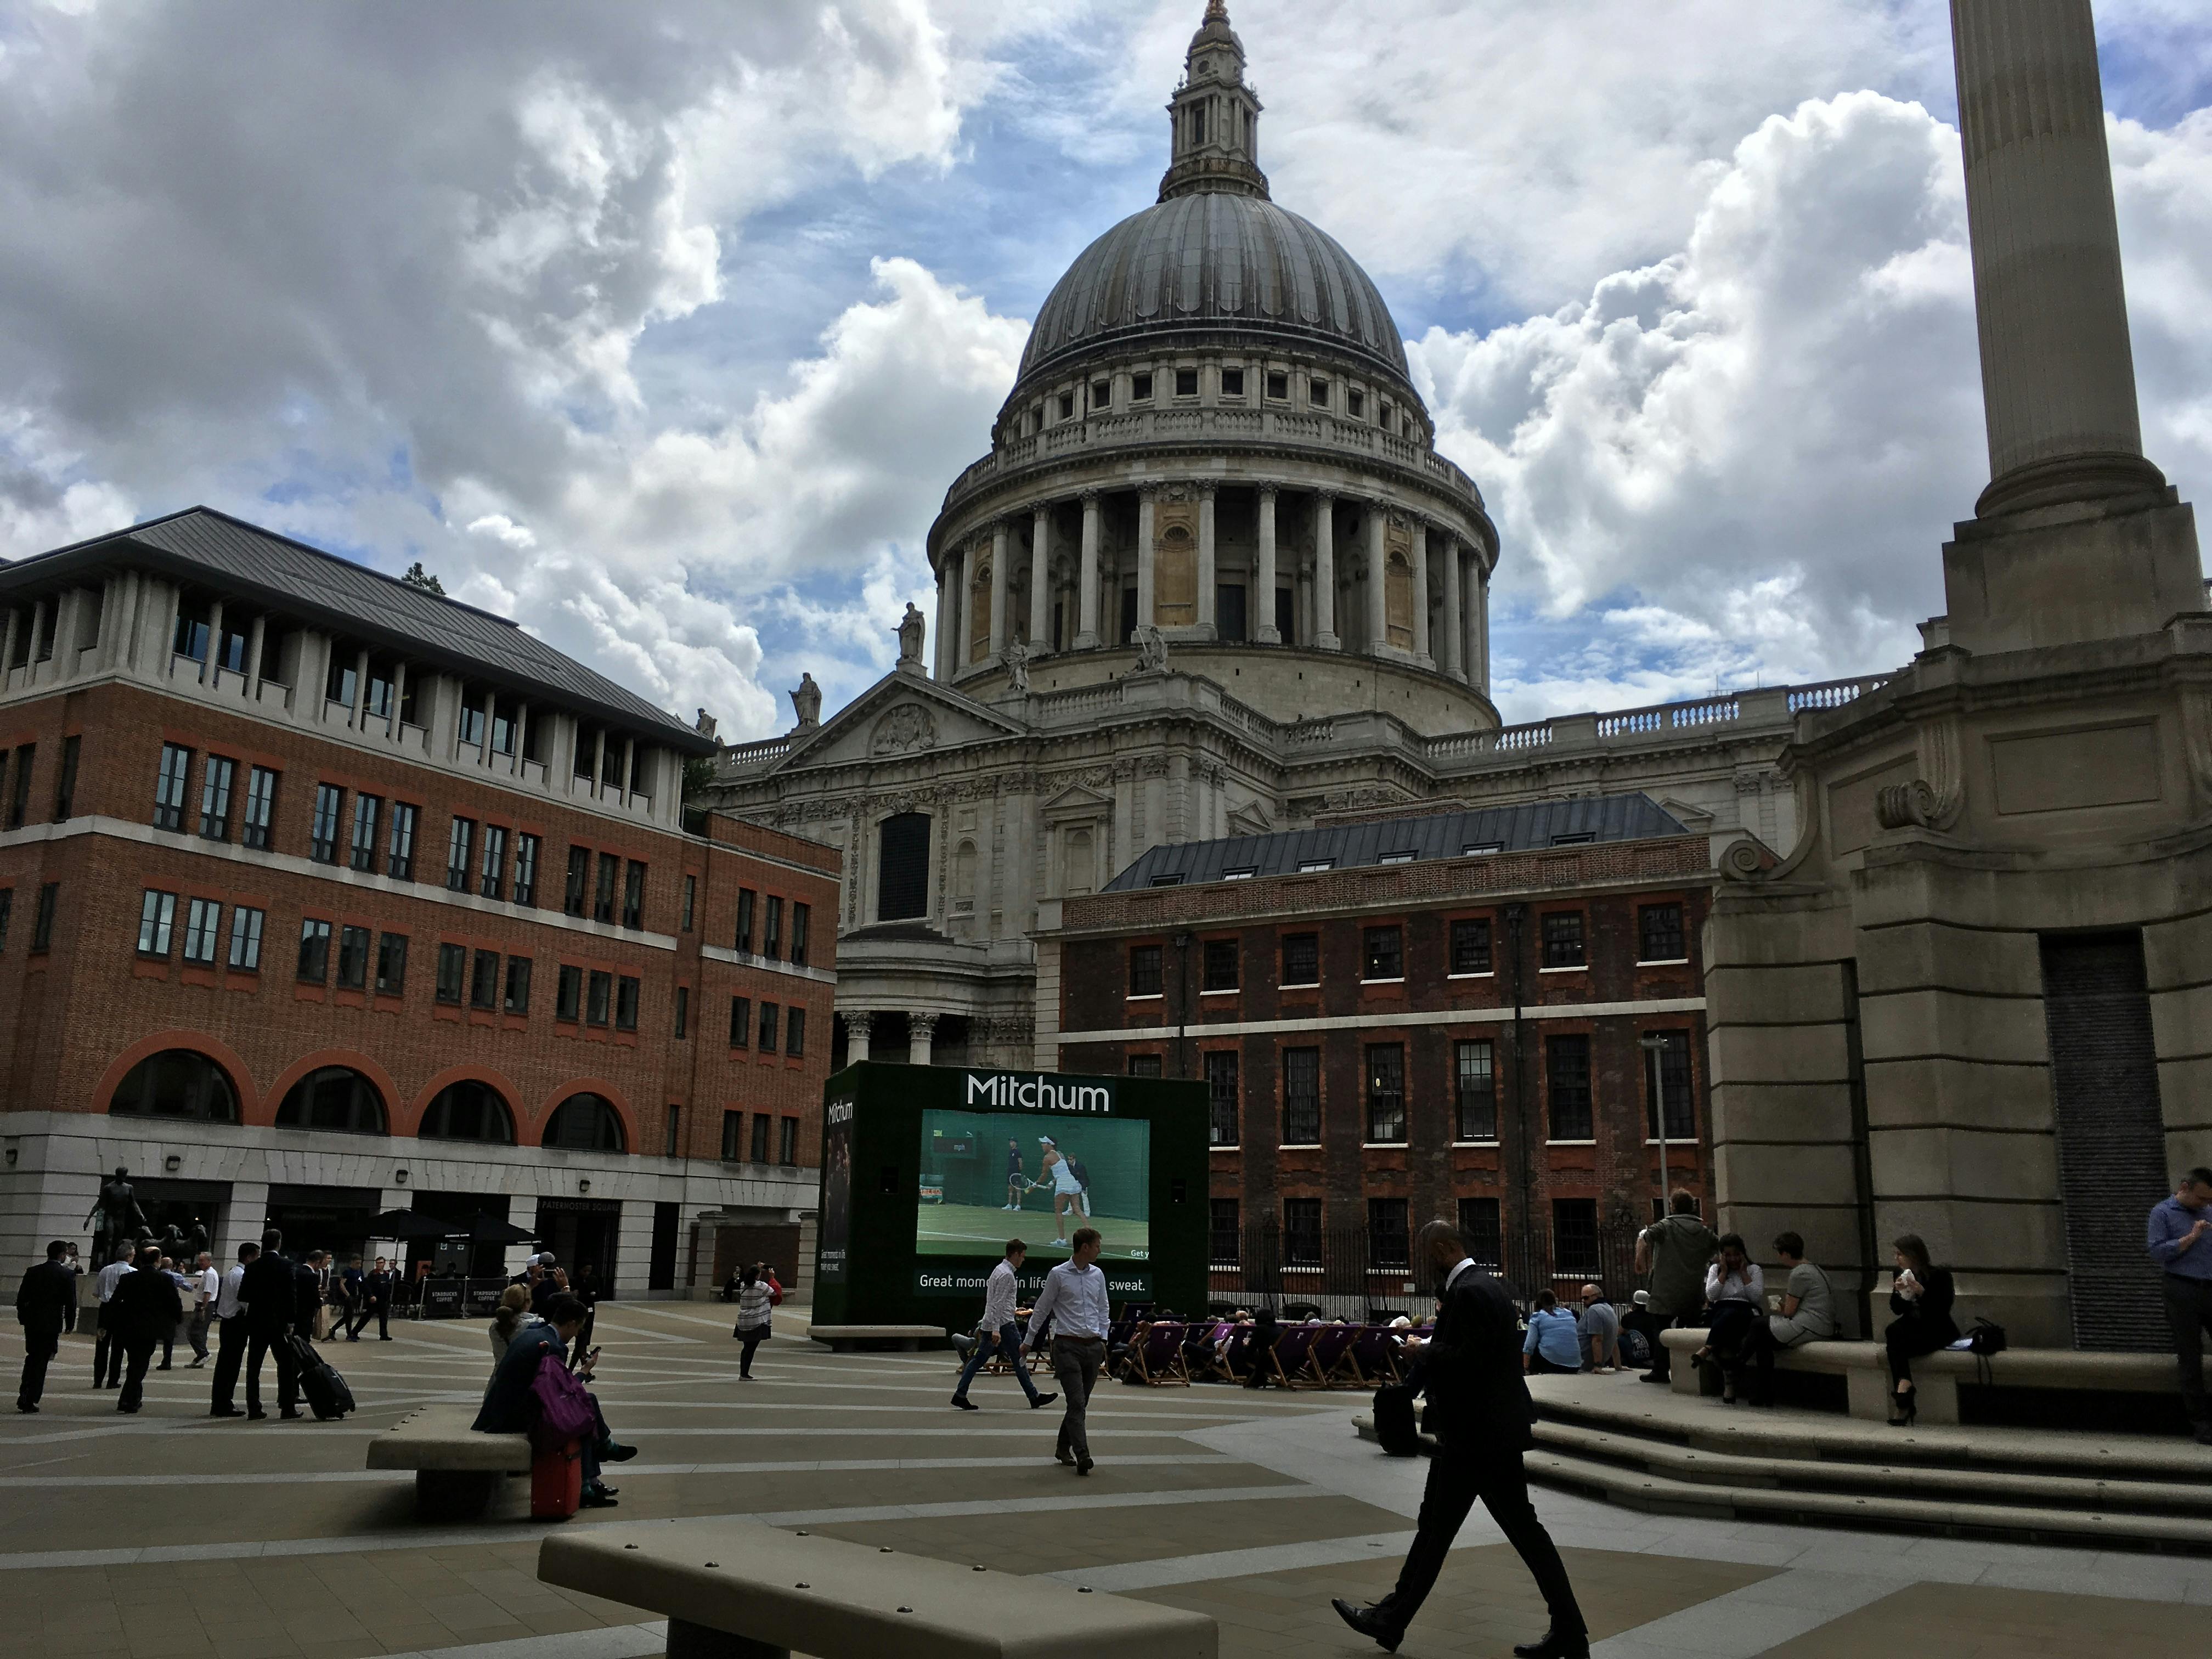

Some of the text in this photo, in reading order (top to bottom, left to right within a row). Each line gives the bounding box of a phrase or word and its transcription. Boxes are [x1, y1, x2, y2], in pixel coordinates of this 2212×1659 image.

[967, 1074, 1109, 1111] Mitchum
[828, 1099, 853, 1125] Mitchum
[542, 1201, 590, 1210] PATERNOSTER
[592, 1203, 619, 1211] SQUARE
[919, 1274, 953, 1287] Great
[1015, 1276, 1025, 1288] in
[1029, 1277, 1046, 1289] life
[1109, 1279, 1146, 1291] sweat.
